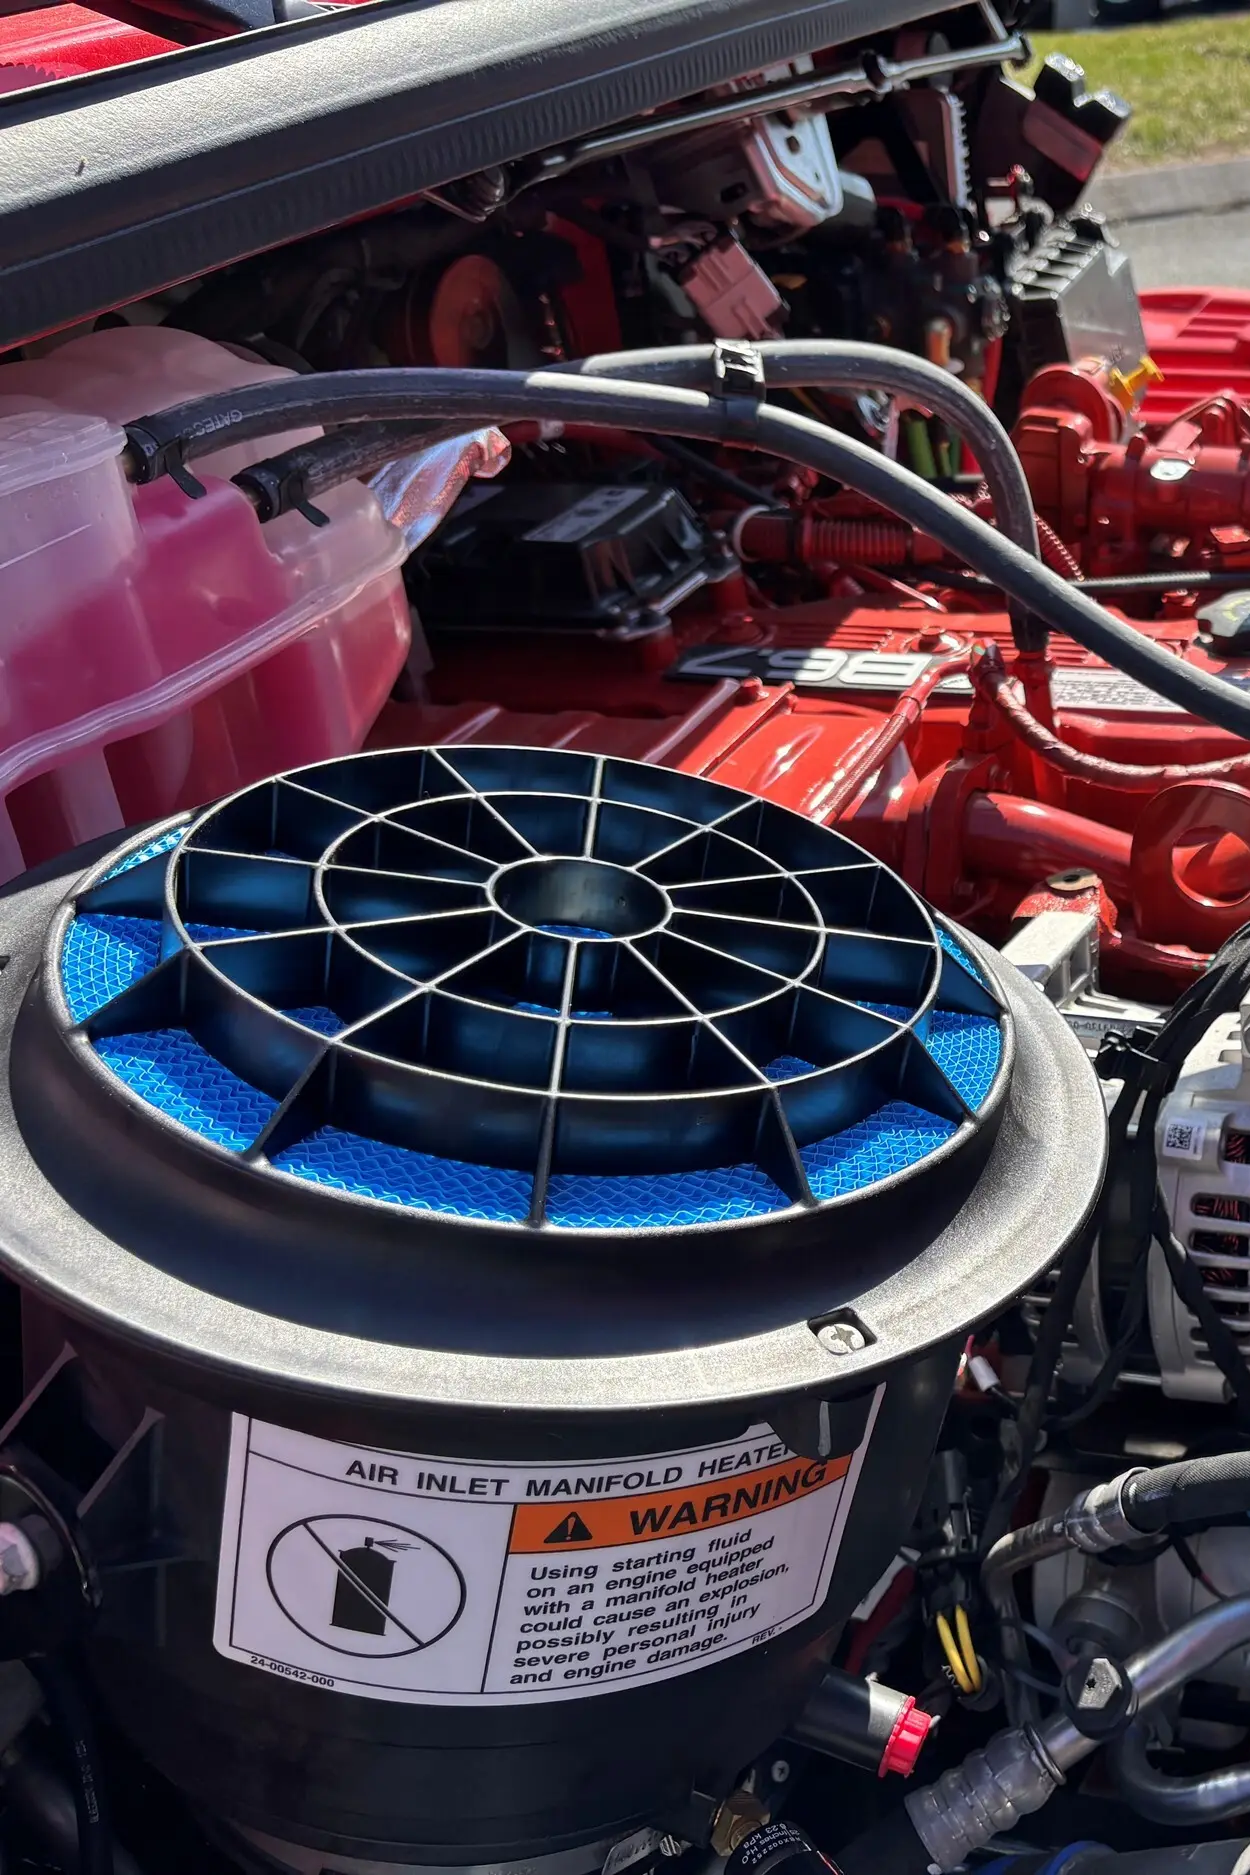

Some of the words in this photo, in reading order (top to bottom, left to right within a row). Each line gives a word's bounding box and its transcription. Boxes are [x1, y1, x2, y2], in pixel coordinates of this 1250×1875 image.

[346, 1460, 399, 1485] AIR
[417, 1471, 510, 1496] INLET
[526, 1466, 683, 1497] MANIFOLD
[697, 1442, 788, 1478] HEATE
[630, 1461, 828, 1536] WARNING
[527, 1586, 556, 1598] on
[567, 1582, 594, 1595] an
[605, 1568, 677, 1590] engine
[687, 1536, 775, 1574] equipped
[531, 1565, 598, 1580] Using
[612, 1547, 696, 1573] starting
[708, 1528, 752, 1552] fluid
[520, 1615, 583, 1633] could
[593, 1606, 656, 1626] cause
[665, 1597, 690, 1612] an
[699, 1562, 789, 1602] explosion,
[524, 1600, 570, 1616] with
[581, 1600, 594, 1611] a
[605, 1577, 696, 1607] manifold
[705, 1557, 764, 1586] heater
[513, 1651, 590, 1667] severe
[602, 1624, 696, 1660] personal
[707, 1603, 761, 1631] injury
[516, 1630, 615, 1653] possibly
[628, 1604, 719, 1637] resulting
[730, 1593, 748, 1608] in
[752, 1629, 776, 1645] REV.
[250, 1655, 335, 1687] 24-00542-000
[510, 1669, 552, 1684] and
[563, 1659, 636, 1679] engine
[646, 1633, 728, 1664] damage.
